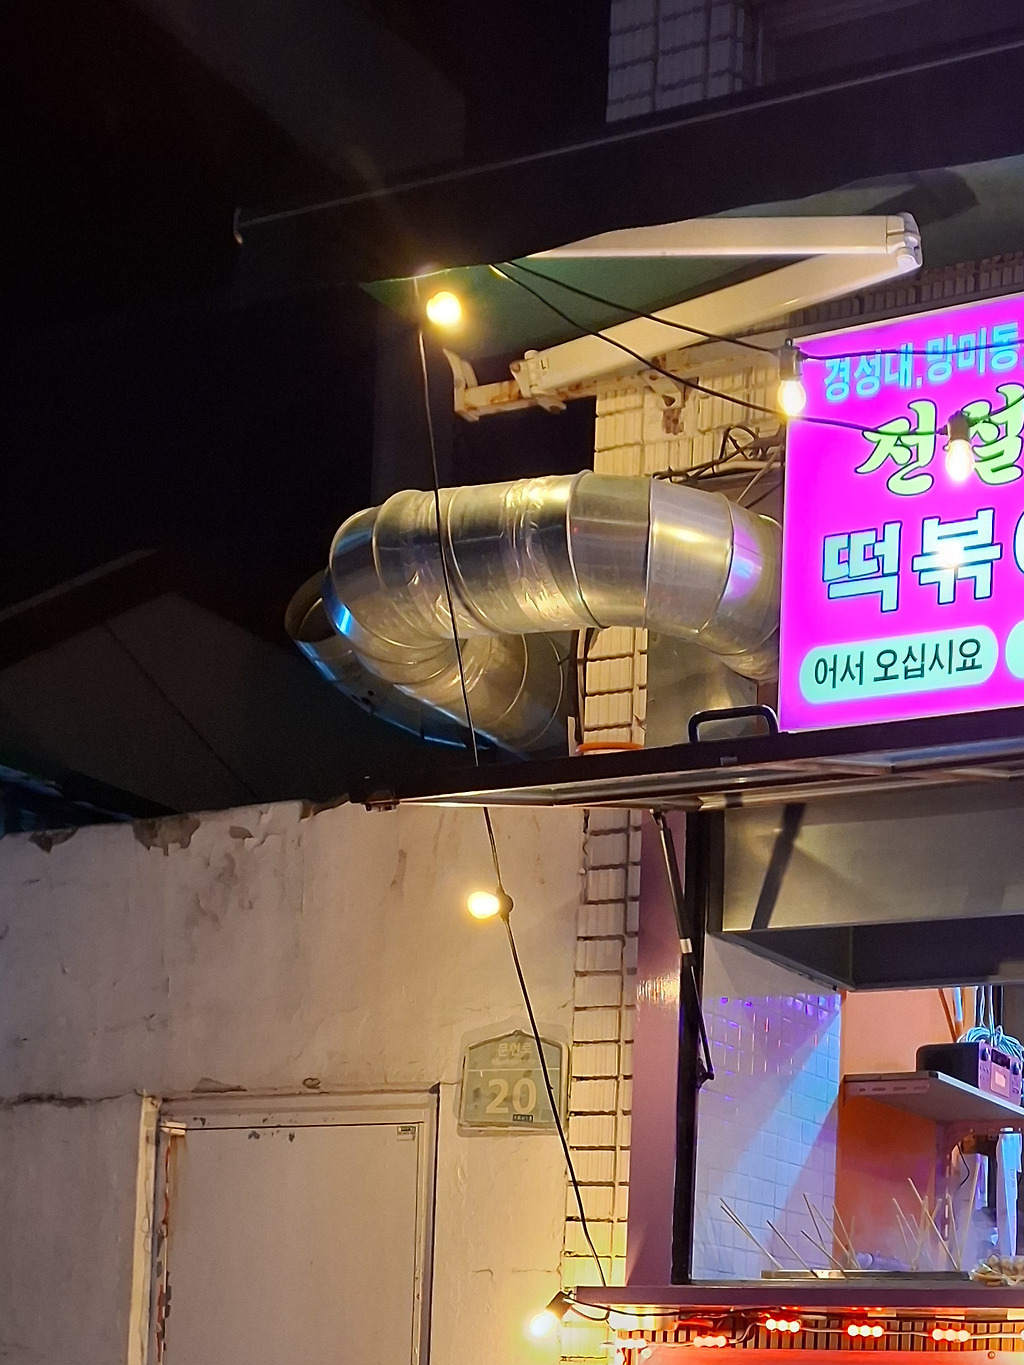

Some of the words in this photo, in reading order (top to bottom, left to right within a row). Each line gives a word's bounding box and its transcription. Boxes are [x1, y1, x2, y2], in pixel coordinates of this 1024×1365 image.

[813, 650, 865, 690] 어서
[873, 637, 983, 684] 오십시요
[485, 1077, 537, 1115] 20
